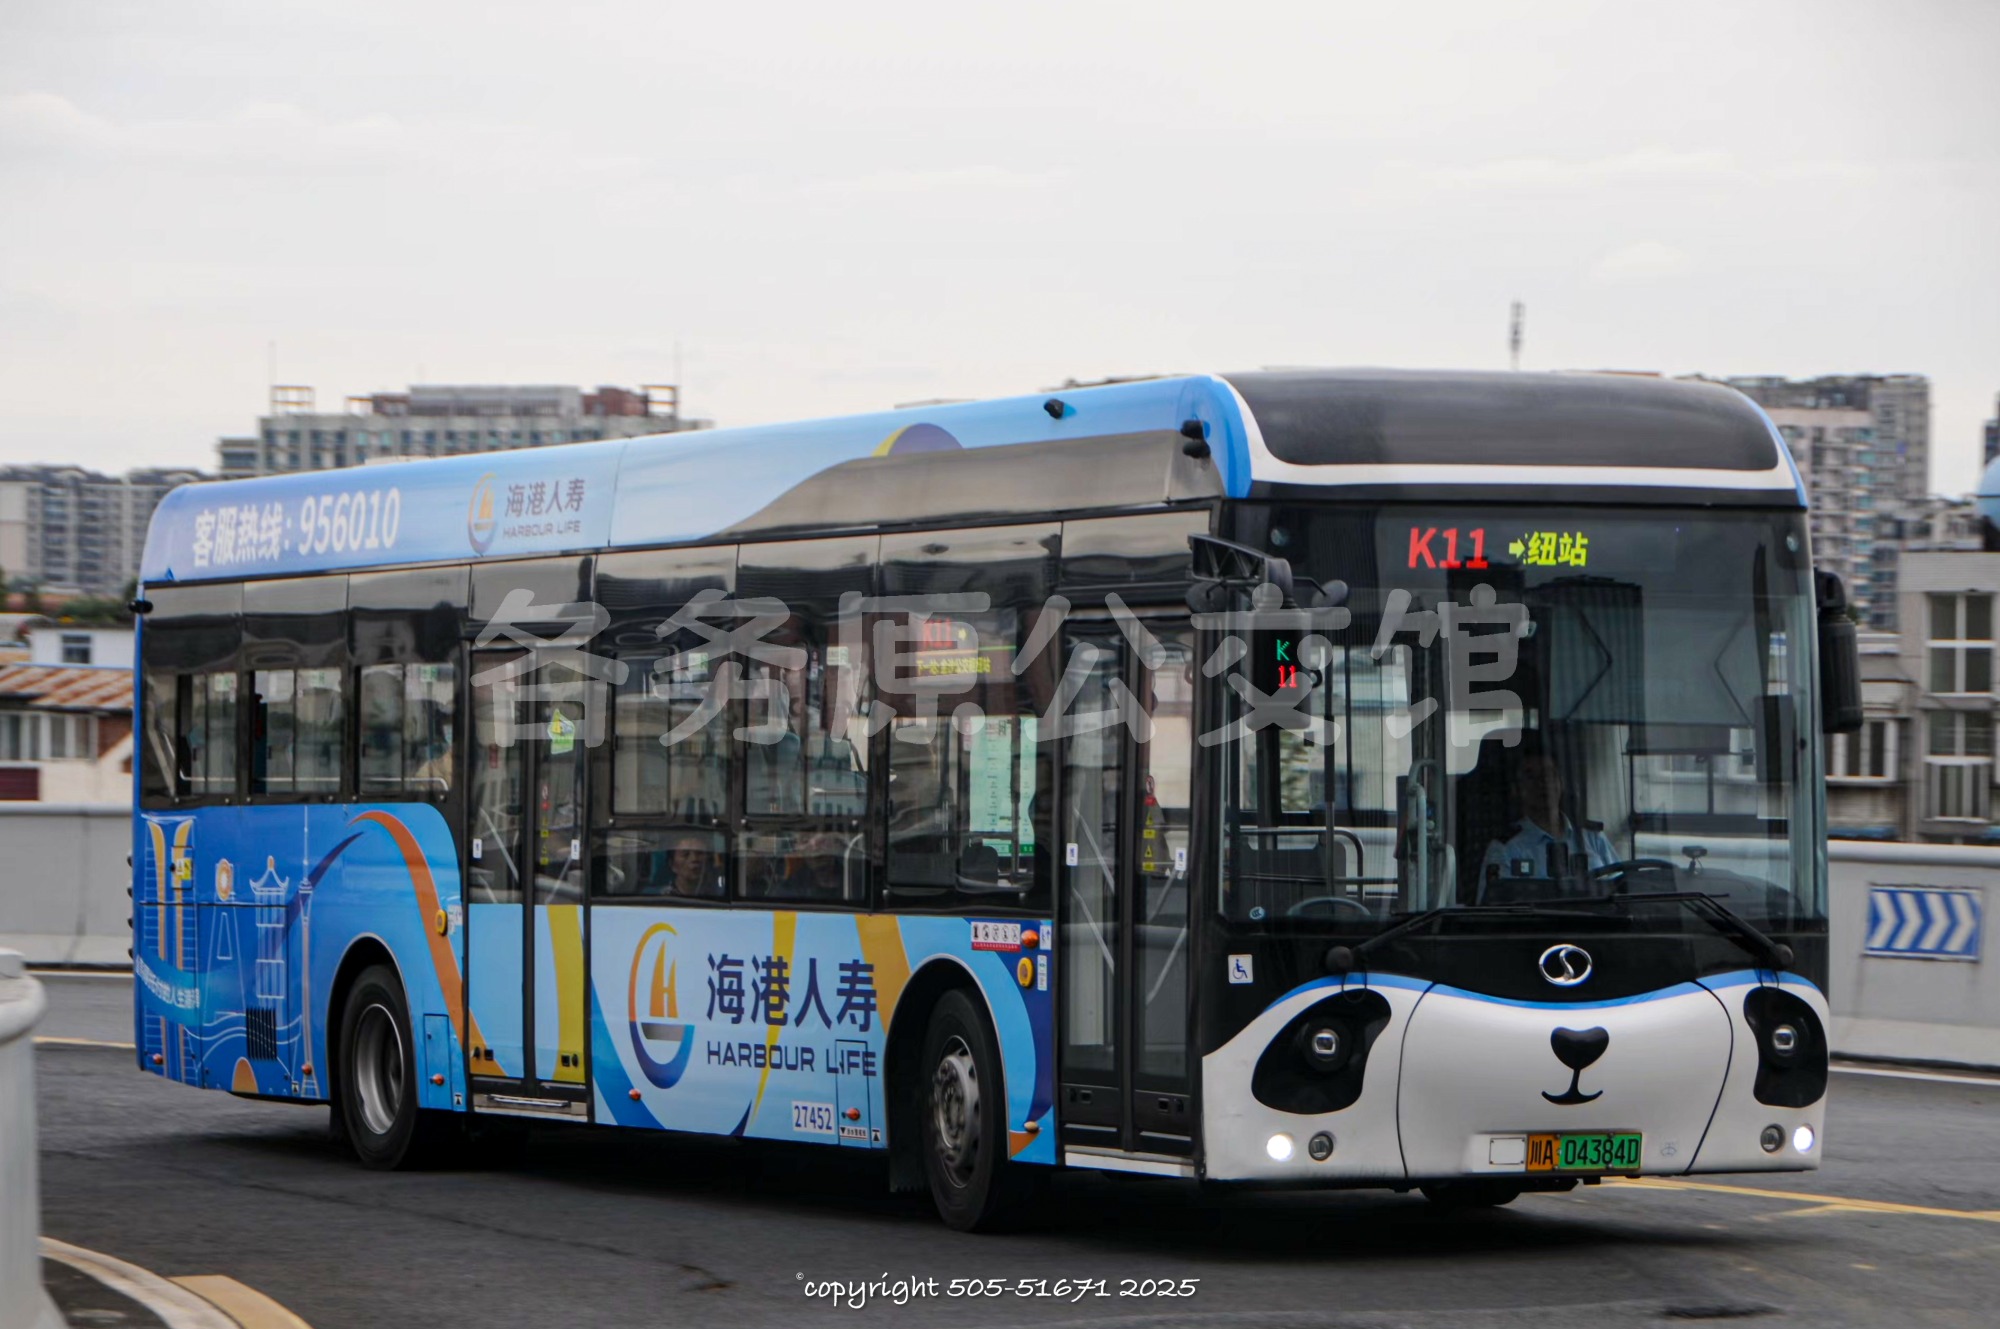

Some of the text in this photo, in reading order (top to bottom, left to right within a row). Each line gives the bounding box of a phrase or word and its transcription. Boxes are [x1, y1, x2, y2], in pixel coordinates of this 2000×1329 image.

[504, 479, 585, 518] 海港人寿
[502, 520, 582, 538] HARBOUR LIFE
[1408, 527, 1488, 568] K11
[1523, 531, 1588, 566] 纽站
[707, 953, 877, 1032] 海港人寿
[707, 1041, 877, 1076] HARBOUR LIFE
[794, 1105, 832, 1131] 27452
